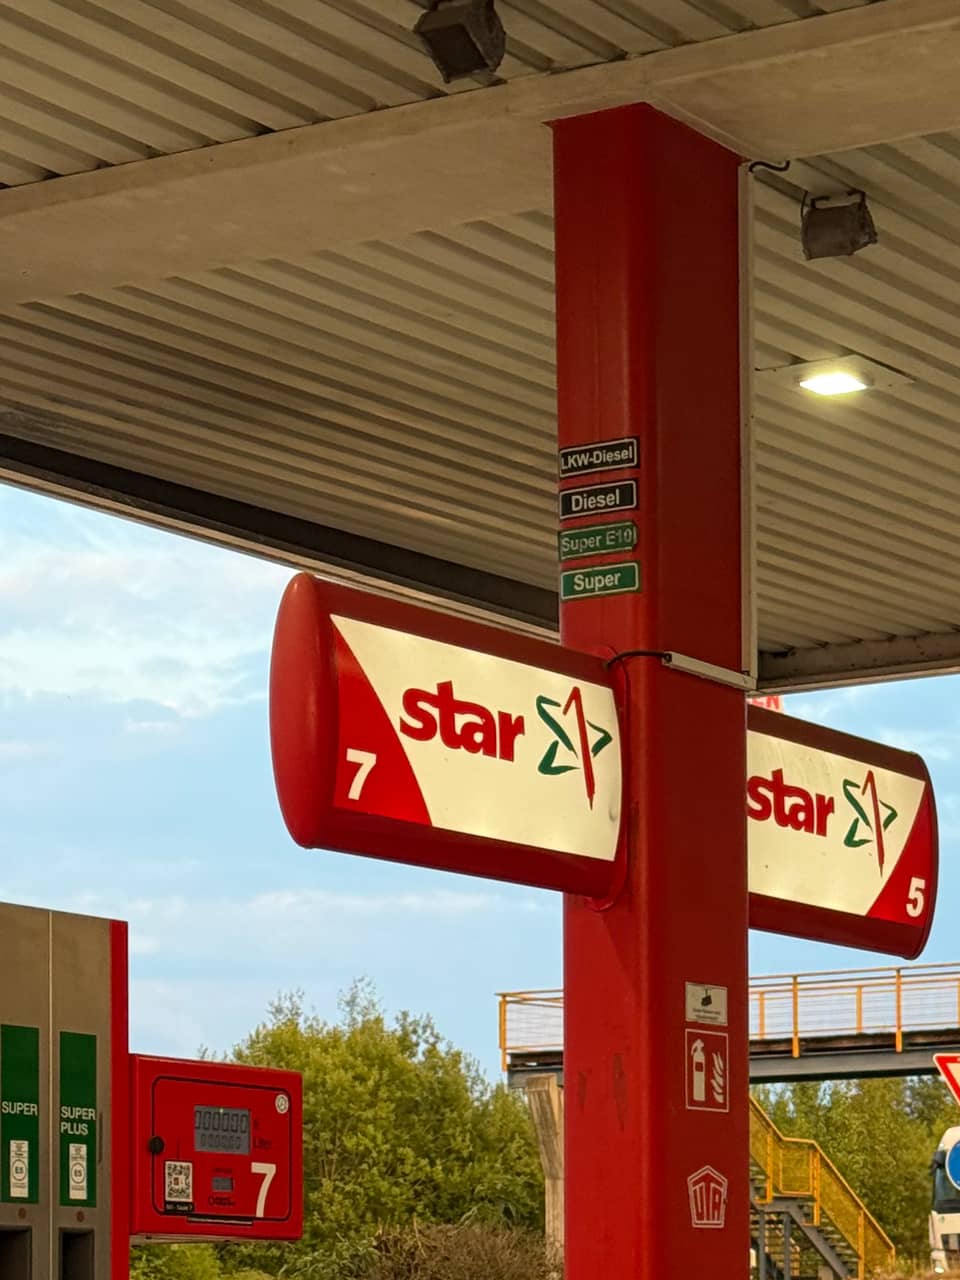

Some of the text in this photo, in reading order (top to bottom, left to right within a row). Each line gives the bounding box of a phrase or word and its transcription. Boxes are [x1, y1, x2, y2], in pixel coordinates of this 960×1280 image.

[561, 446, 633, 469] LKW-Diesel
[571, 489, 620, 511] Diesel
[562, 529, 632, 552] Super E10
[573, 572, 621, 592] Super
[400, 679, 525, 761] star
[346, 748, 377, 800] 7
[746, 768, 835, 837] star
[905, 877, 925, 917] 5
[2, 1101, 38, 1116] SUPER
[60, 1106, 96, 1120] SUPER
[61, 1121, 88, 1135] PLUS
[251, 1162, 276, 1217] 7
